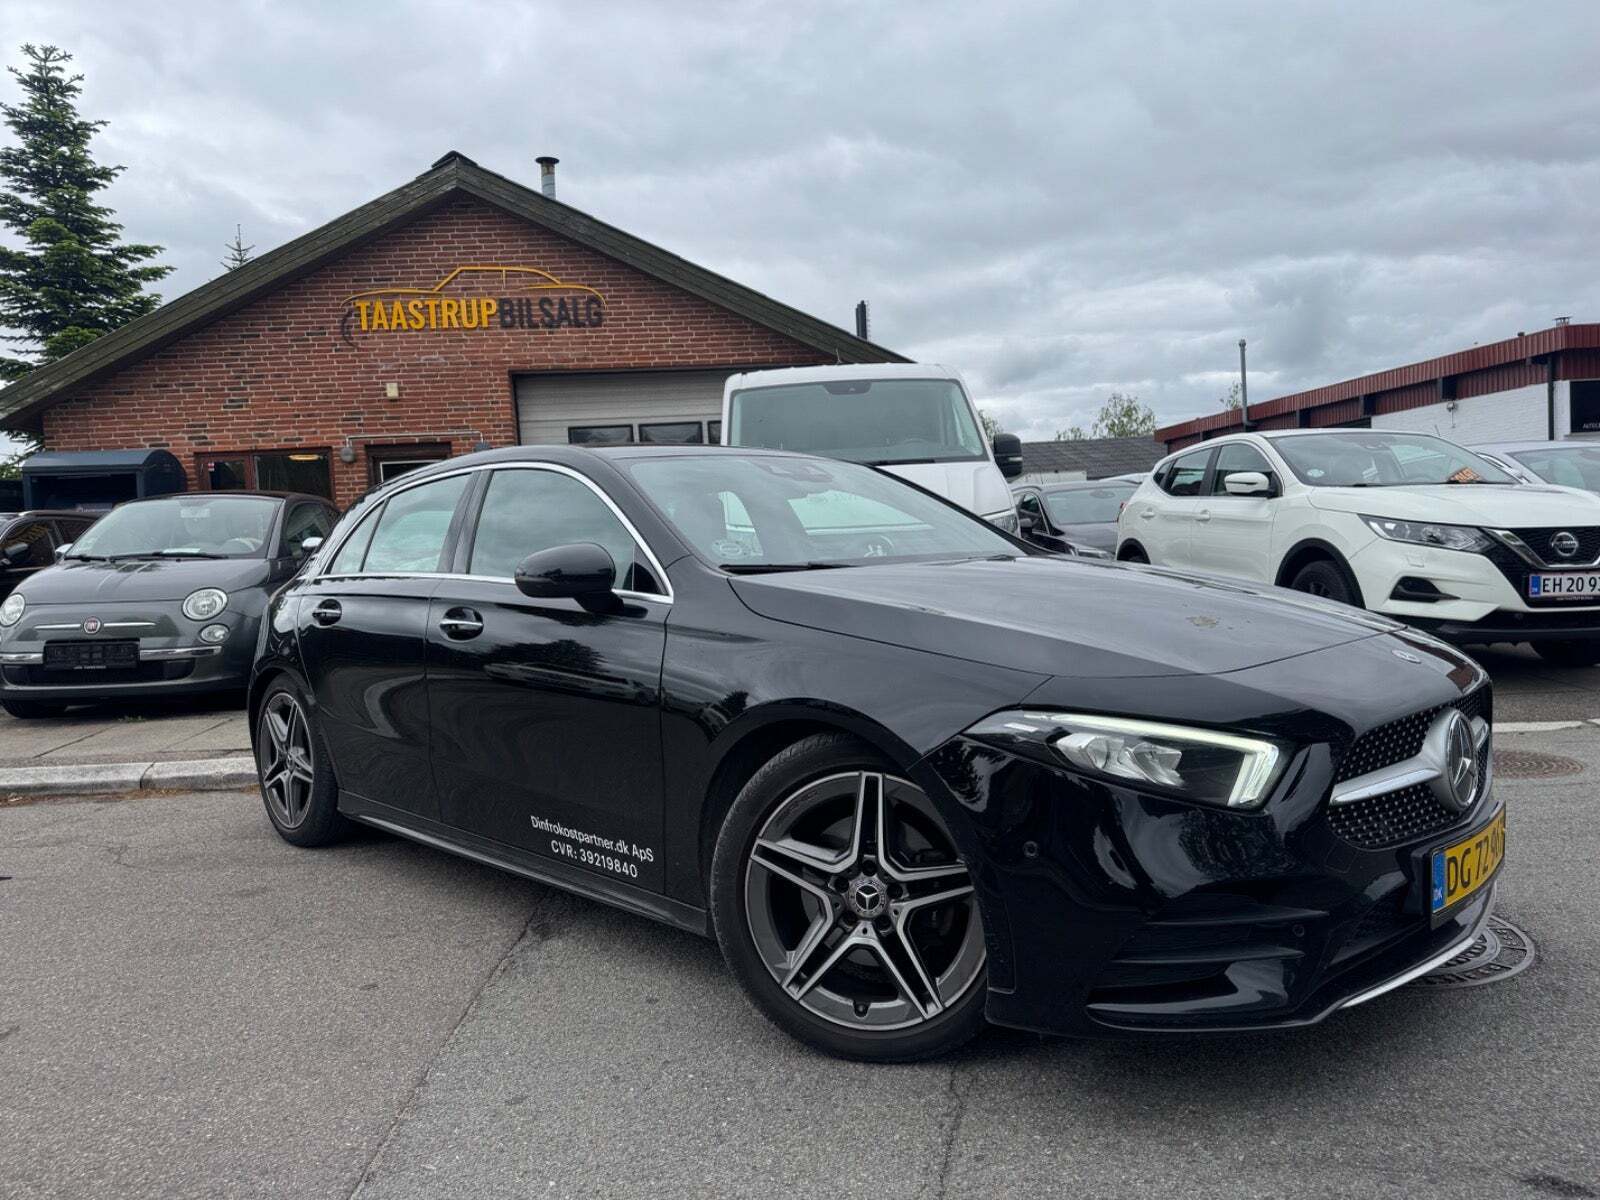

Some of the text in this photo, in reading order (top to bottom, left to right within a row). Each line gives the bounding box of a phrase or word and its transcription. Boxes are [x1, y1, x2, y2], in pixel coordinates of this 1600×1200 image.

[1542, 577, 1563, 593] EH
[1566, 577, 1585, 593] 20
[530, 815, 654, 863] Dinfrokostpartner.dk ApS
[551, 840, 638, 878] CVR: 39219840
[1447, 847, 1471, 897] DG
